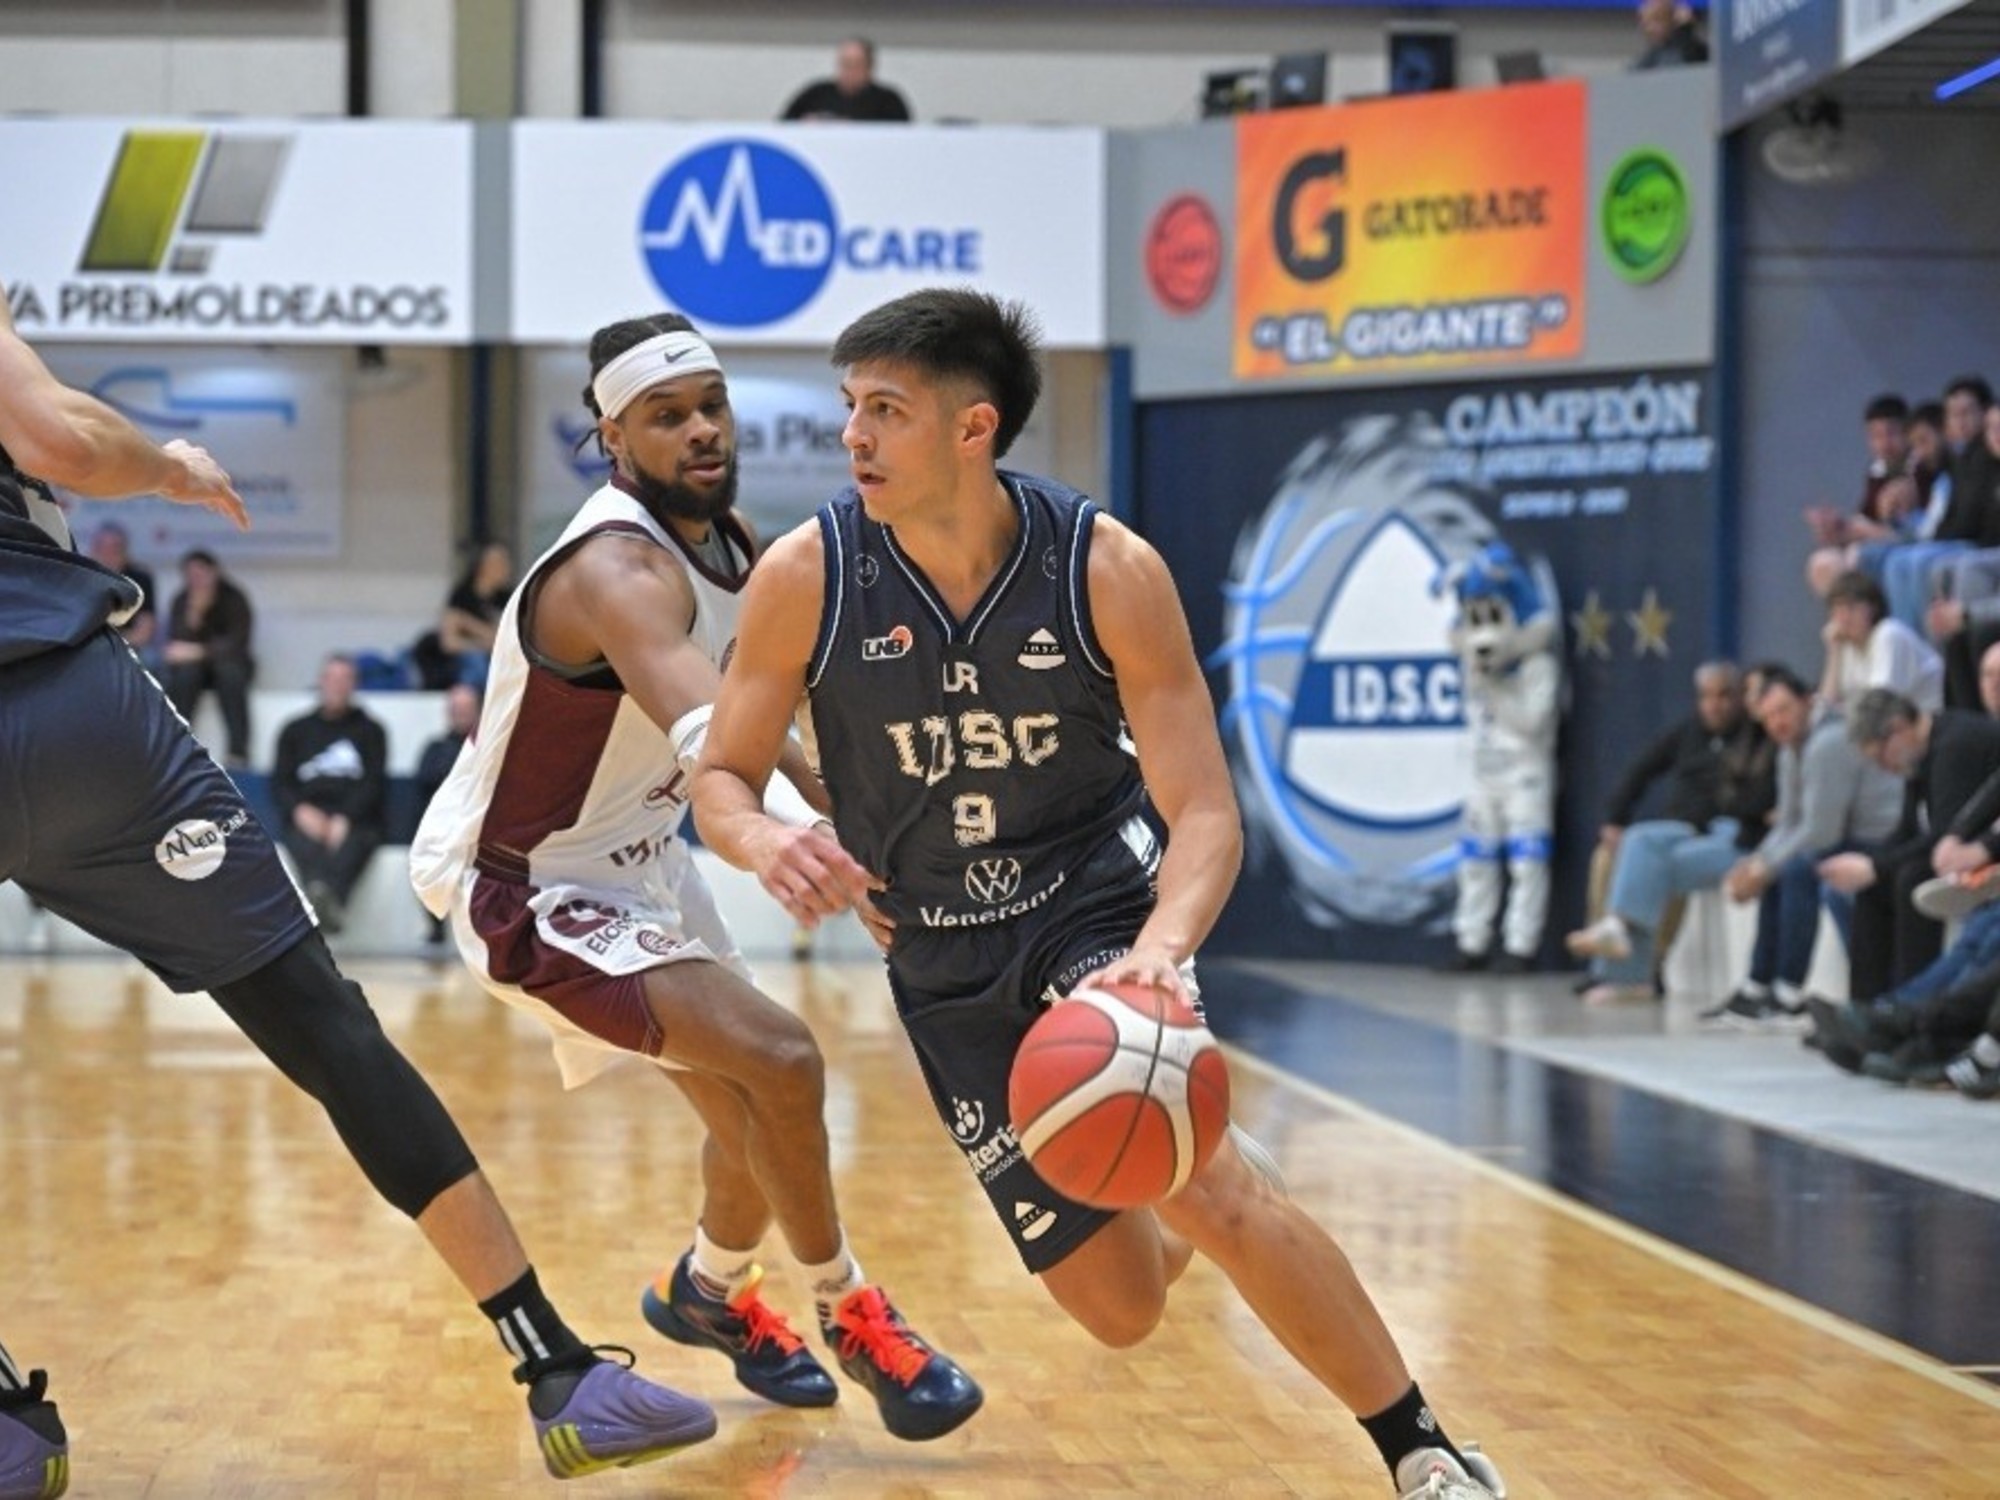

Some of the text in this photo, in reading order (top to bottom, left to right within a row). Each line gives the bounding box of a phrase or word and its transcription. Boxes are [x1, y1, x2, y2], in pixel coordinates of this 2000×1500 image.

[1271, 147, 1348, 283] G
[1363, 187, 1551, 239] GATORADE
[59, 284, 449, 327] PREMOLDEADOS
[1447, 376, 1700, 443] CAMPEÓN
[952, 792, 997, 848] 9
